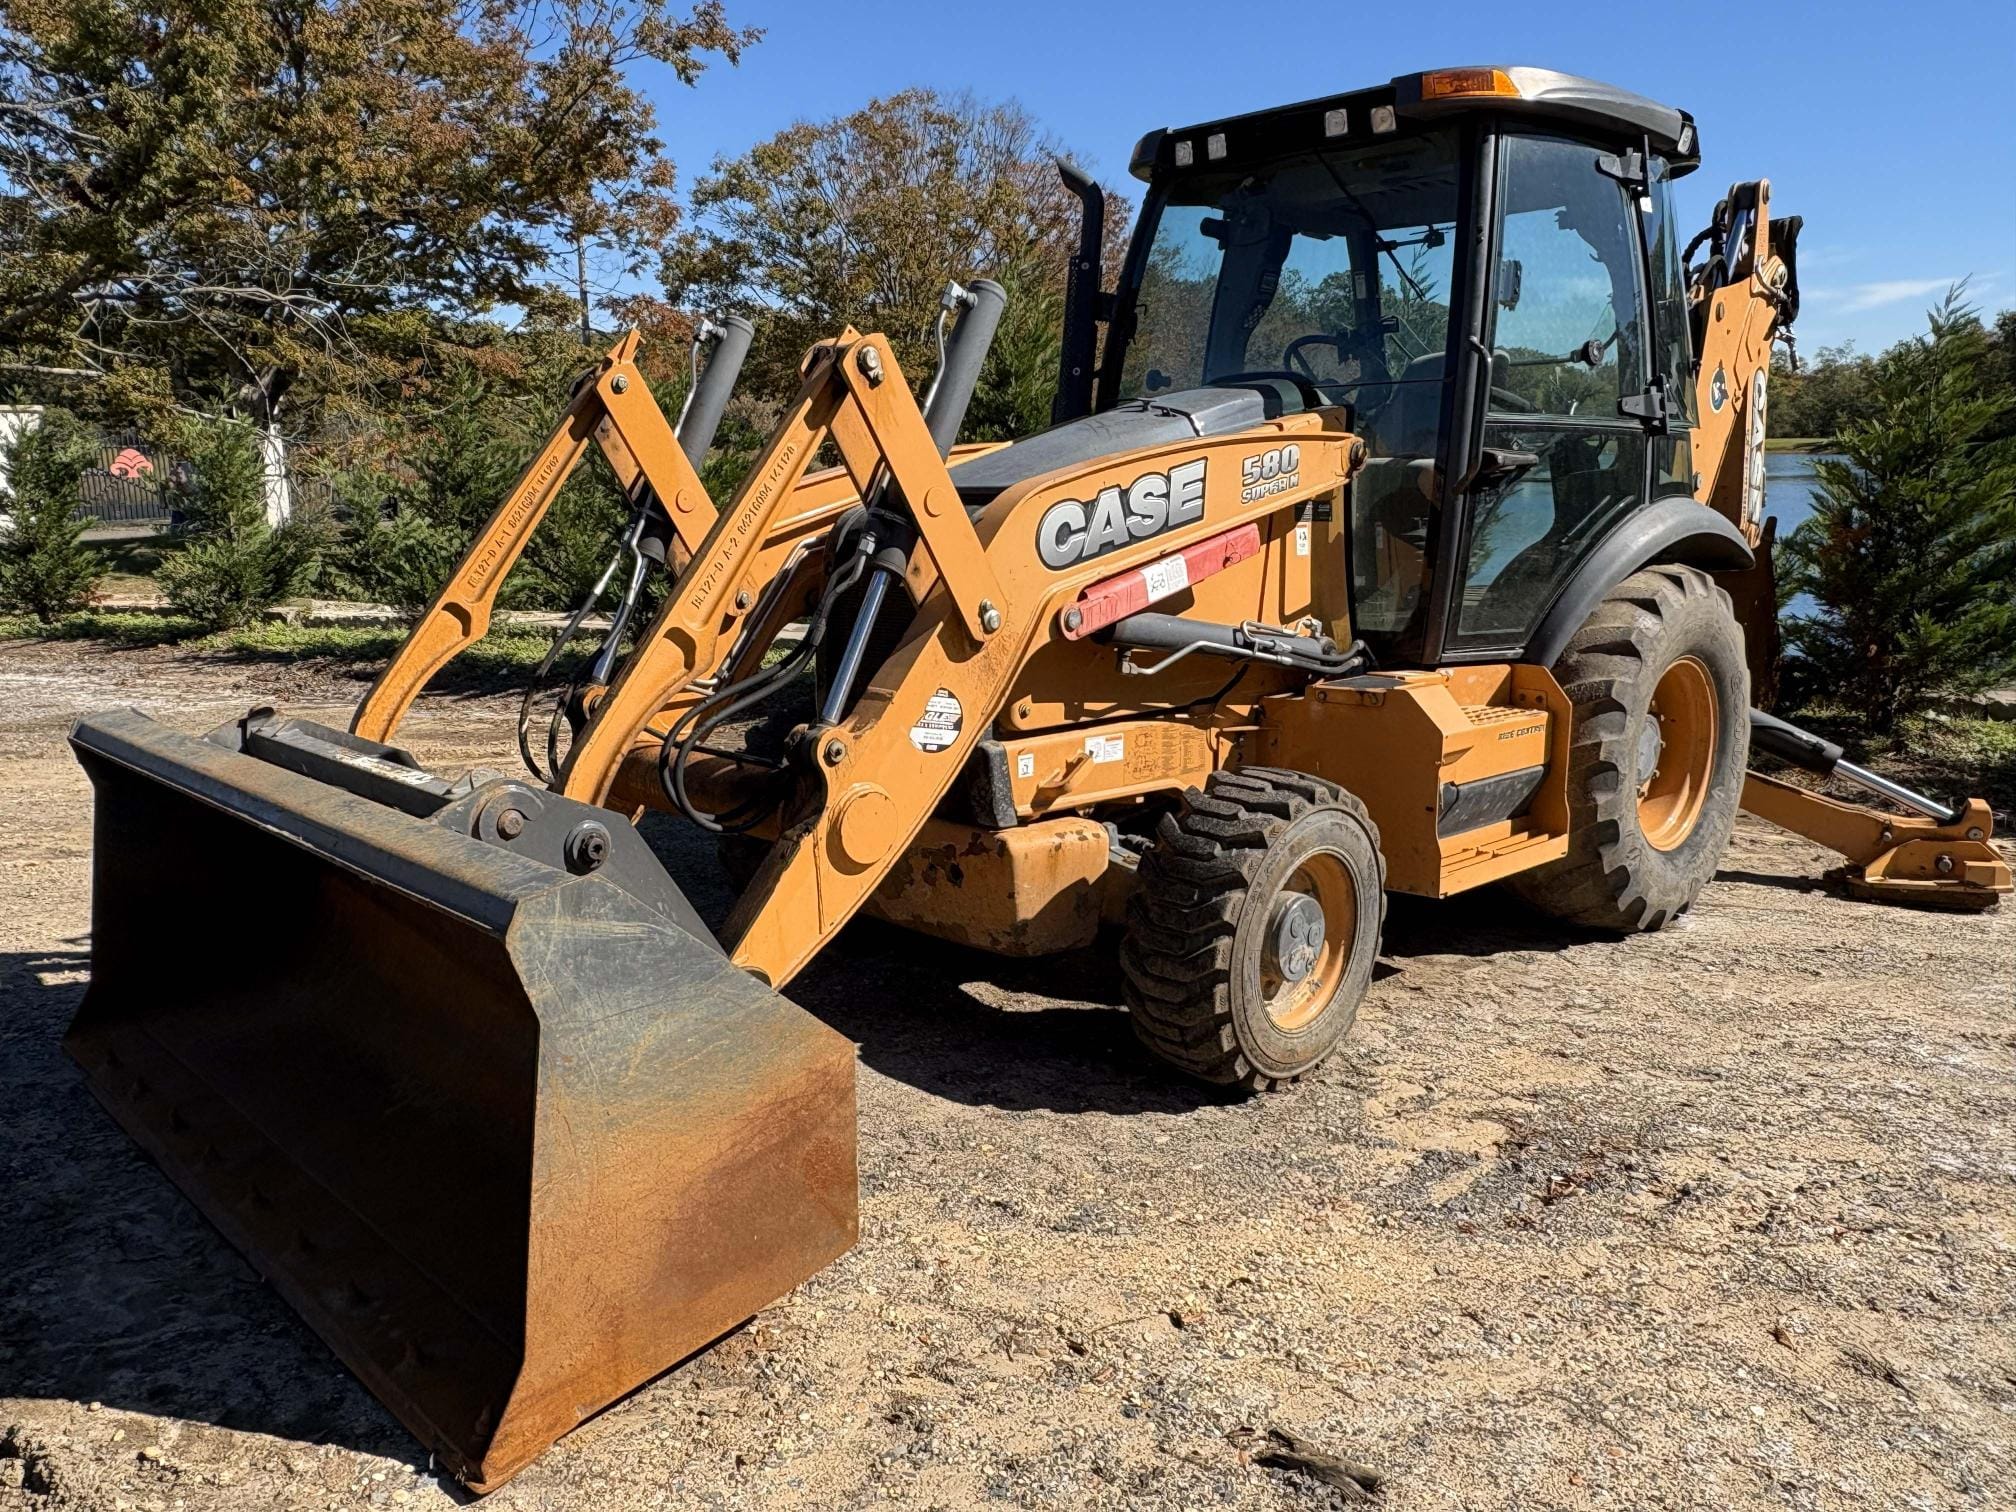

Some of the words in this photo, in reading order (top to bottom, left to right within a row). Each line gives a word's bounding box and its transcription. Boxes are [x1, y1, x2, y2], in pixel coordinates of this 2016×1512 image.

[1241, 443, 1300, 488] 580
[1750, 367, 1767, 526] CASE
[1037, 457, 1206, 570] CASE
[1240, 477, 1288, 505] SUPER
